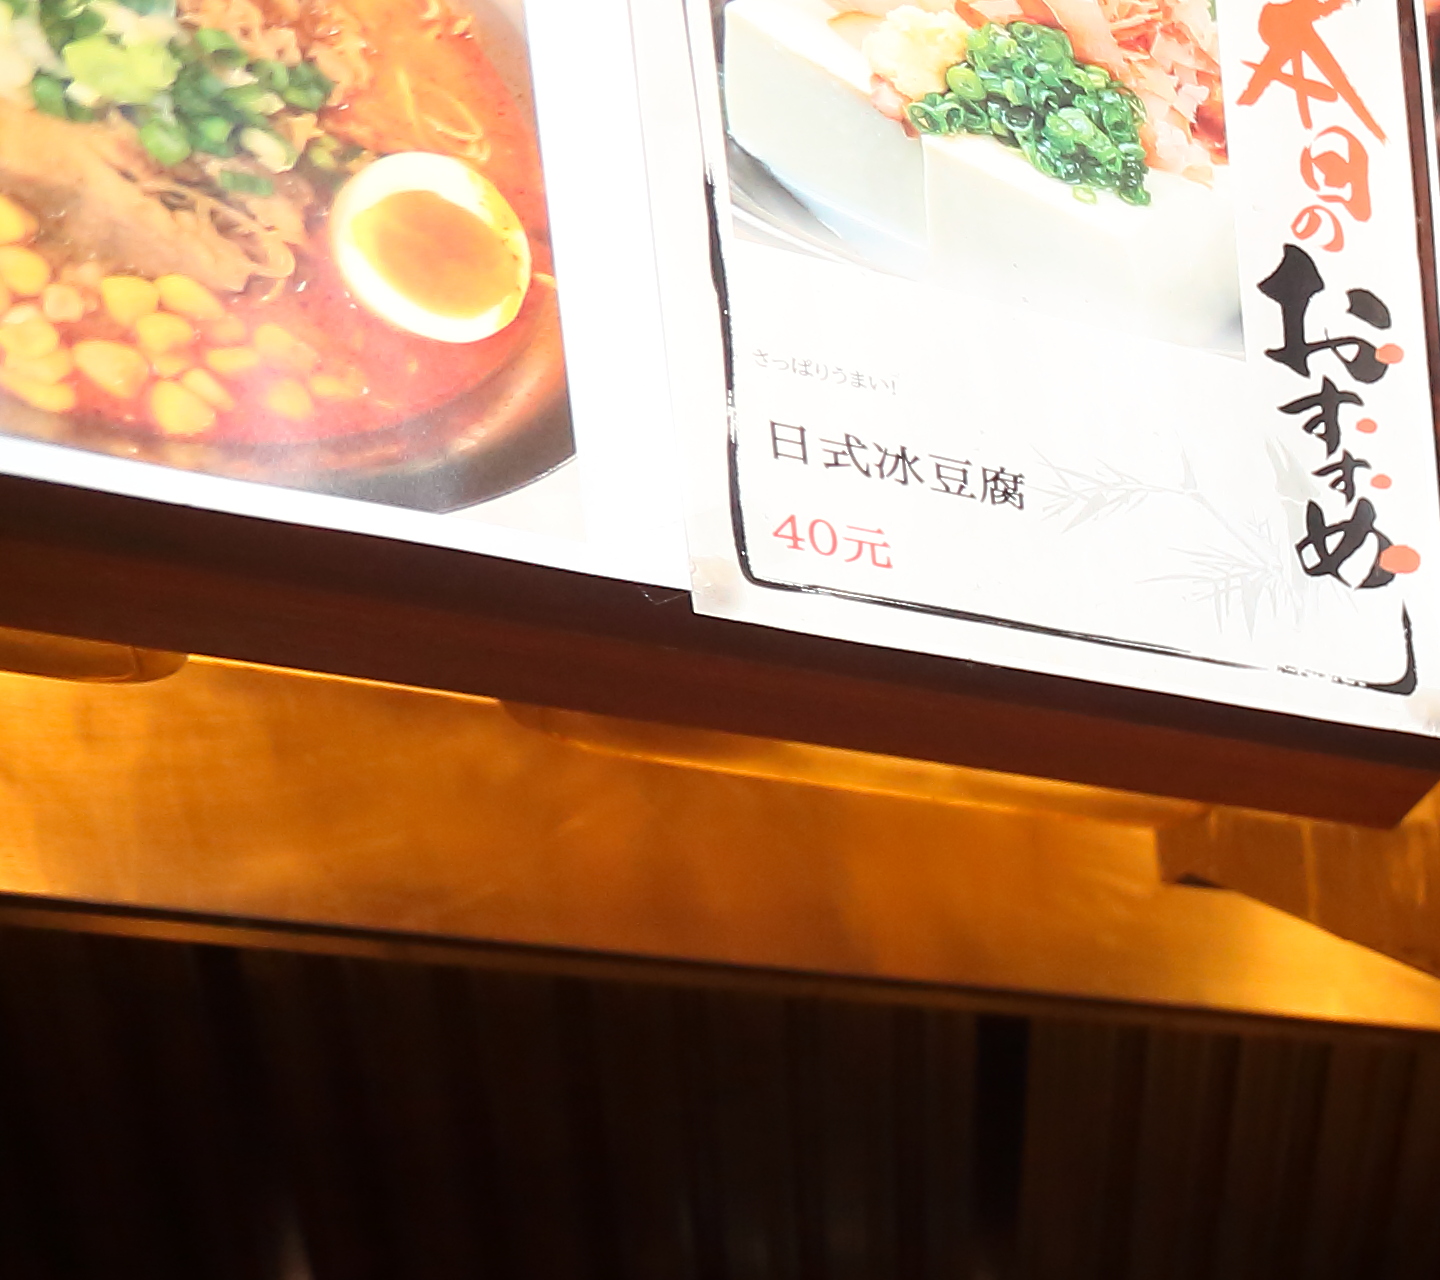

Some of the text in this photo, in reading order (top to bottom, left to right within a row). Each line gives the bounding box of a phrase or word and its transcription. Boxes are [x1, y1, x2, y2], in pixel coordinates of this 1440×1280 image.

[753, 349, 897, 396] さっぱりうまい!
[767, 419, 1026, 512] 日式冰豆腐
[771, 513, 894, 570] 40元
